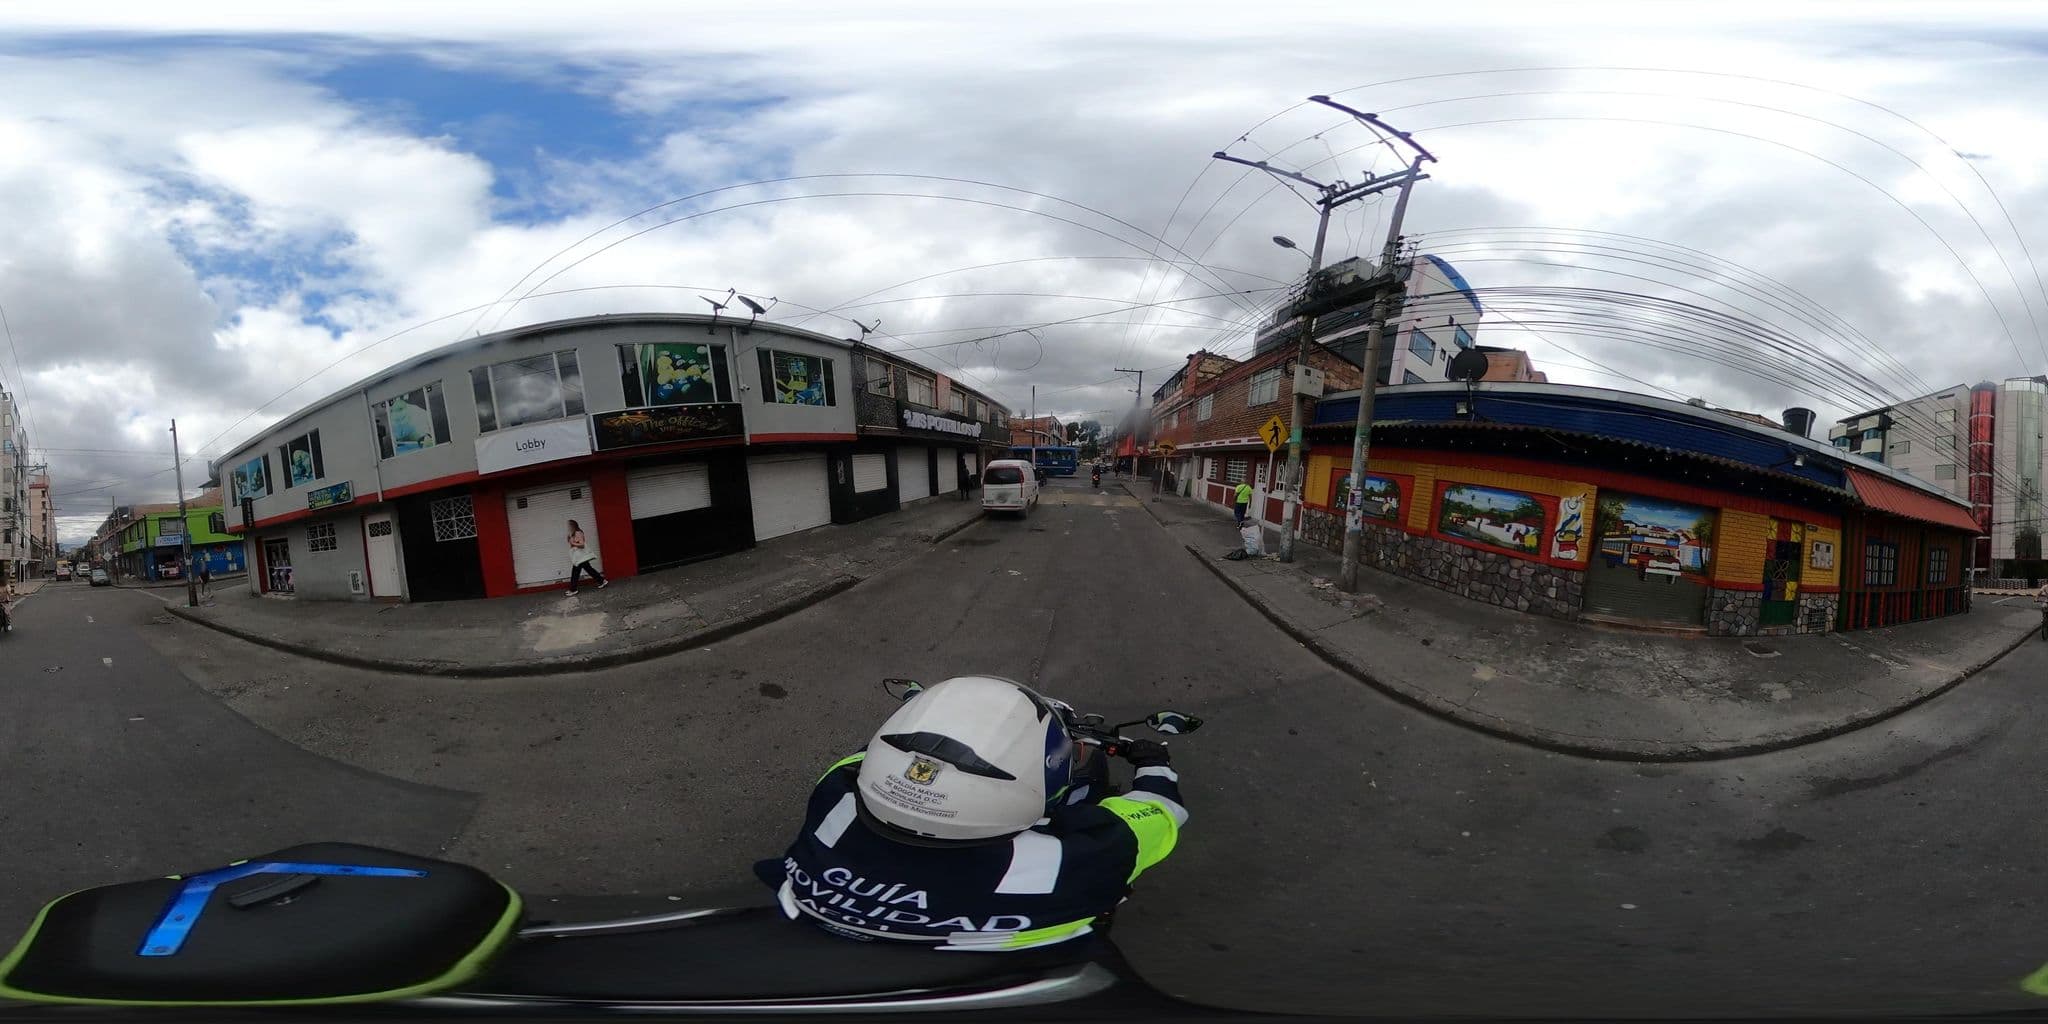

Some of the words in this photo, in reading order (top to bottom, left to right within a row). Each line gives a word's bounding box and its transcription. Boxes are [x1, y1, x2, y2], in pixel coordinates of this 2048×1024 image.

[515, 438, 547, 451] Lobby
[916, 788, 946, 800] MAYOR
[784, 857, 1033, 934] MOVILIDAD
[822, 866, 929, 910] GUÍA
